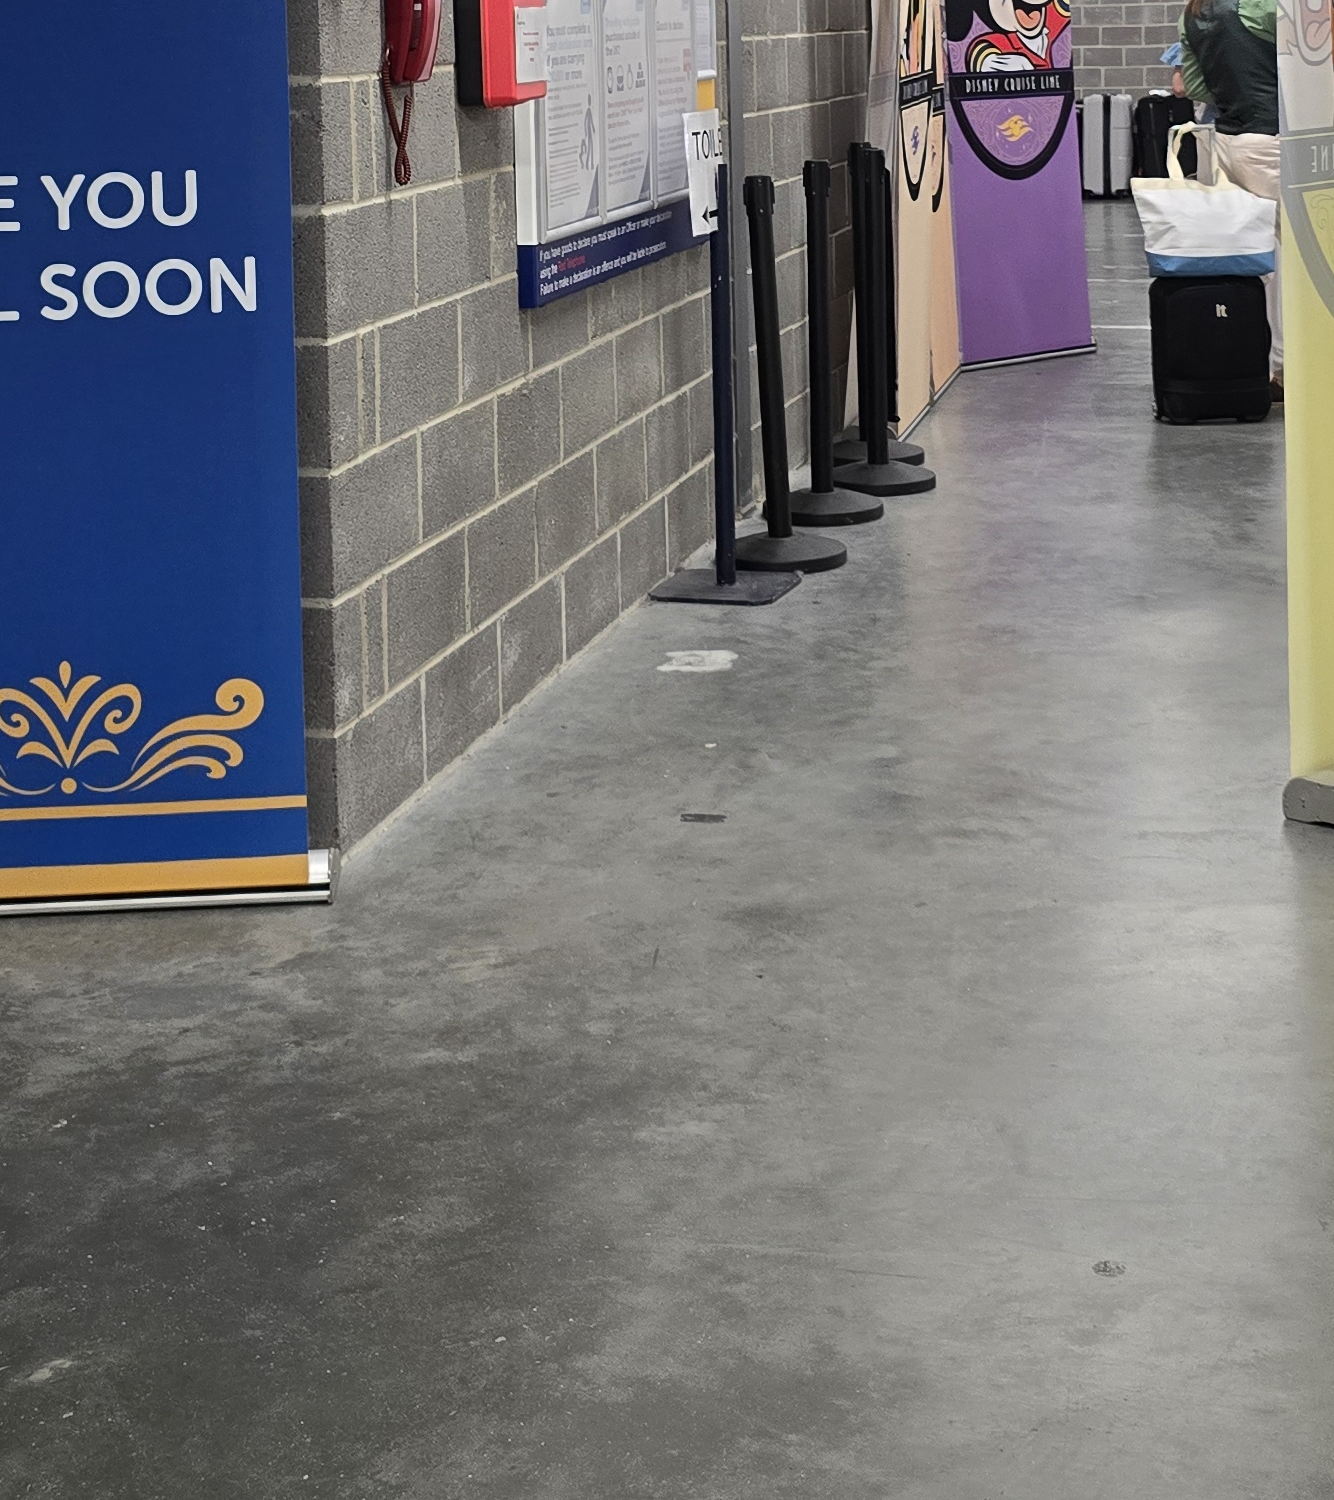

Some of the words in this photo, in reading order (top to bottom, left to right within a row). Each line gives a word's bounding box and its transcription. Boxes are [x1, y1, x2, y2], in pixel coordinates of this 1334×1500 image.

[965, 78, 999, 93] DISNEY
[1004, 76, 1036, 90] CRUISE
[1040, 75, 1061, 89] LINE
[40, 169, 198, 231] YOU
[39, 256, 257, 321] SOON
